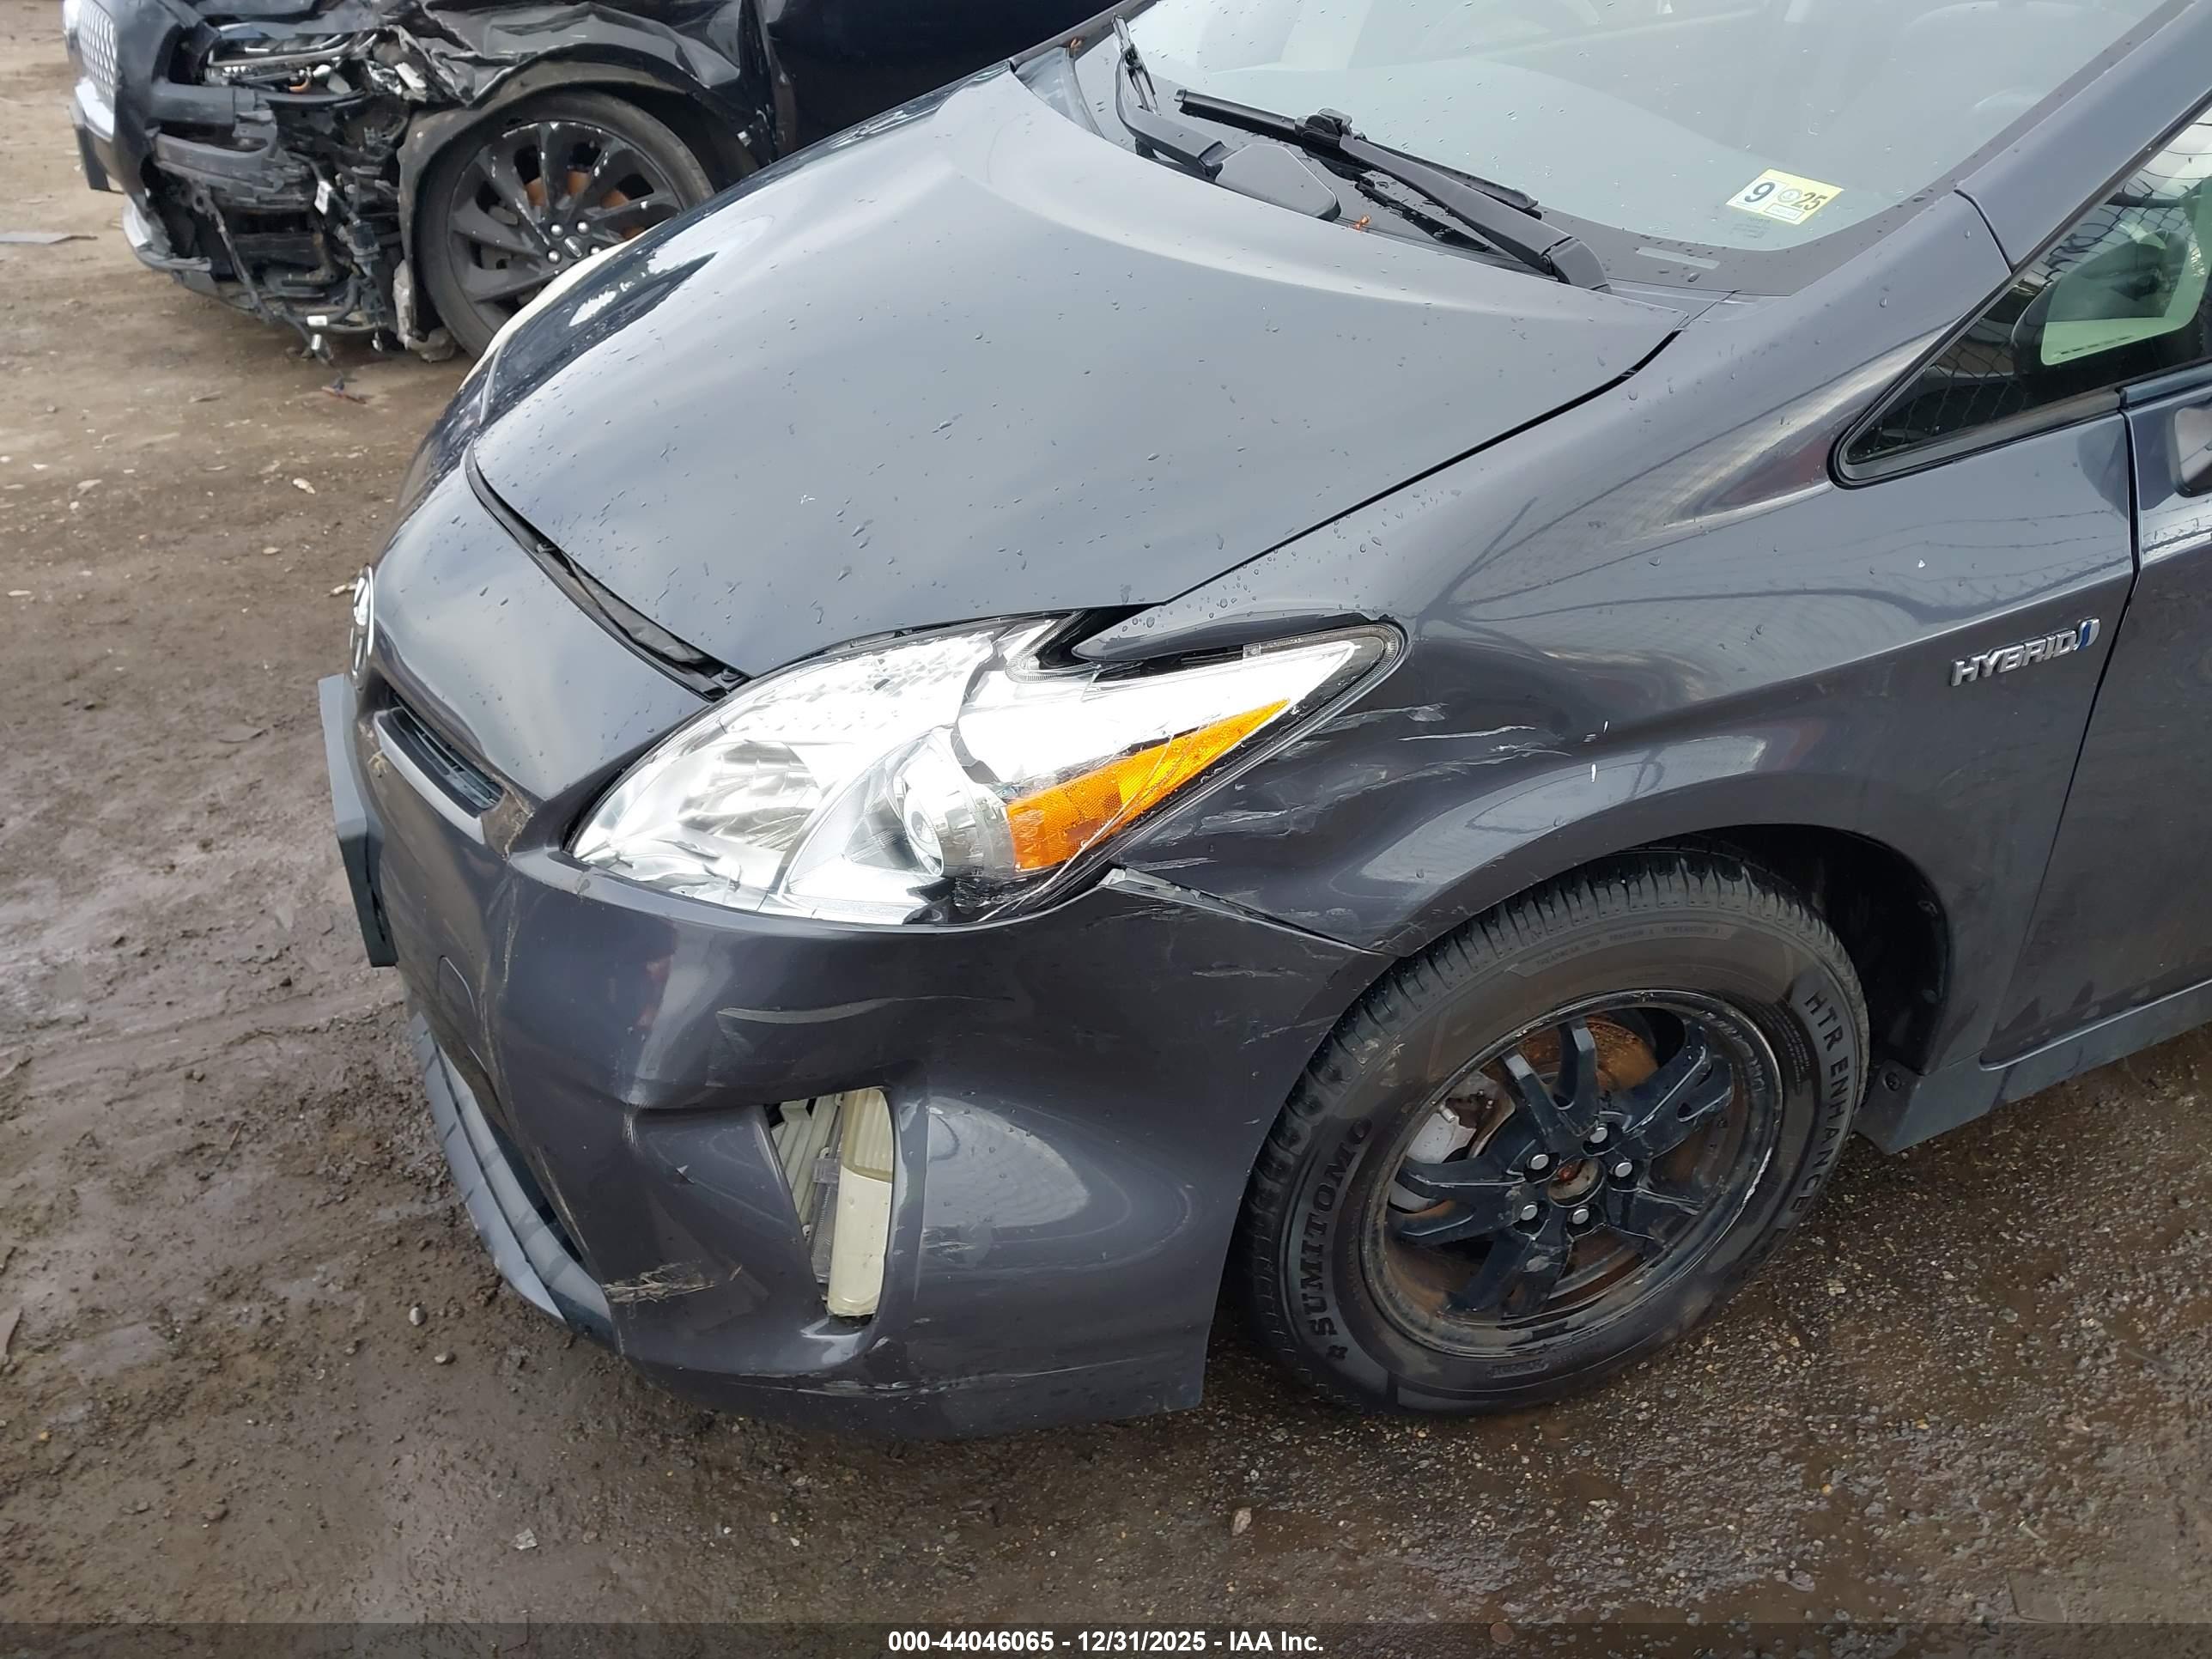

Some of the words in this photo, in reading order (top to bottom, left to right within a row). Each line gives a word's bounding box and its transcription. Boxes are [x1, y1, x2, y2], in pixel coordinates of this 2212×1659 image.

[1744, 181, 1776, 203] 9
[1790, 191, 1828, 210] 25
[1950, 629, 2077, 687] HYBRID
[1804, 989, 1844, 1052] HTR
[1299, 1118, 1372, 1336] SUMITOMO
